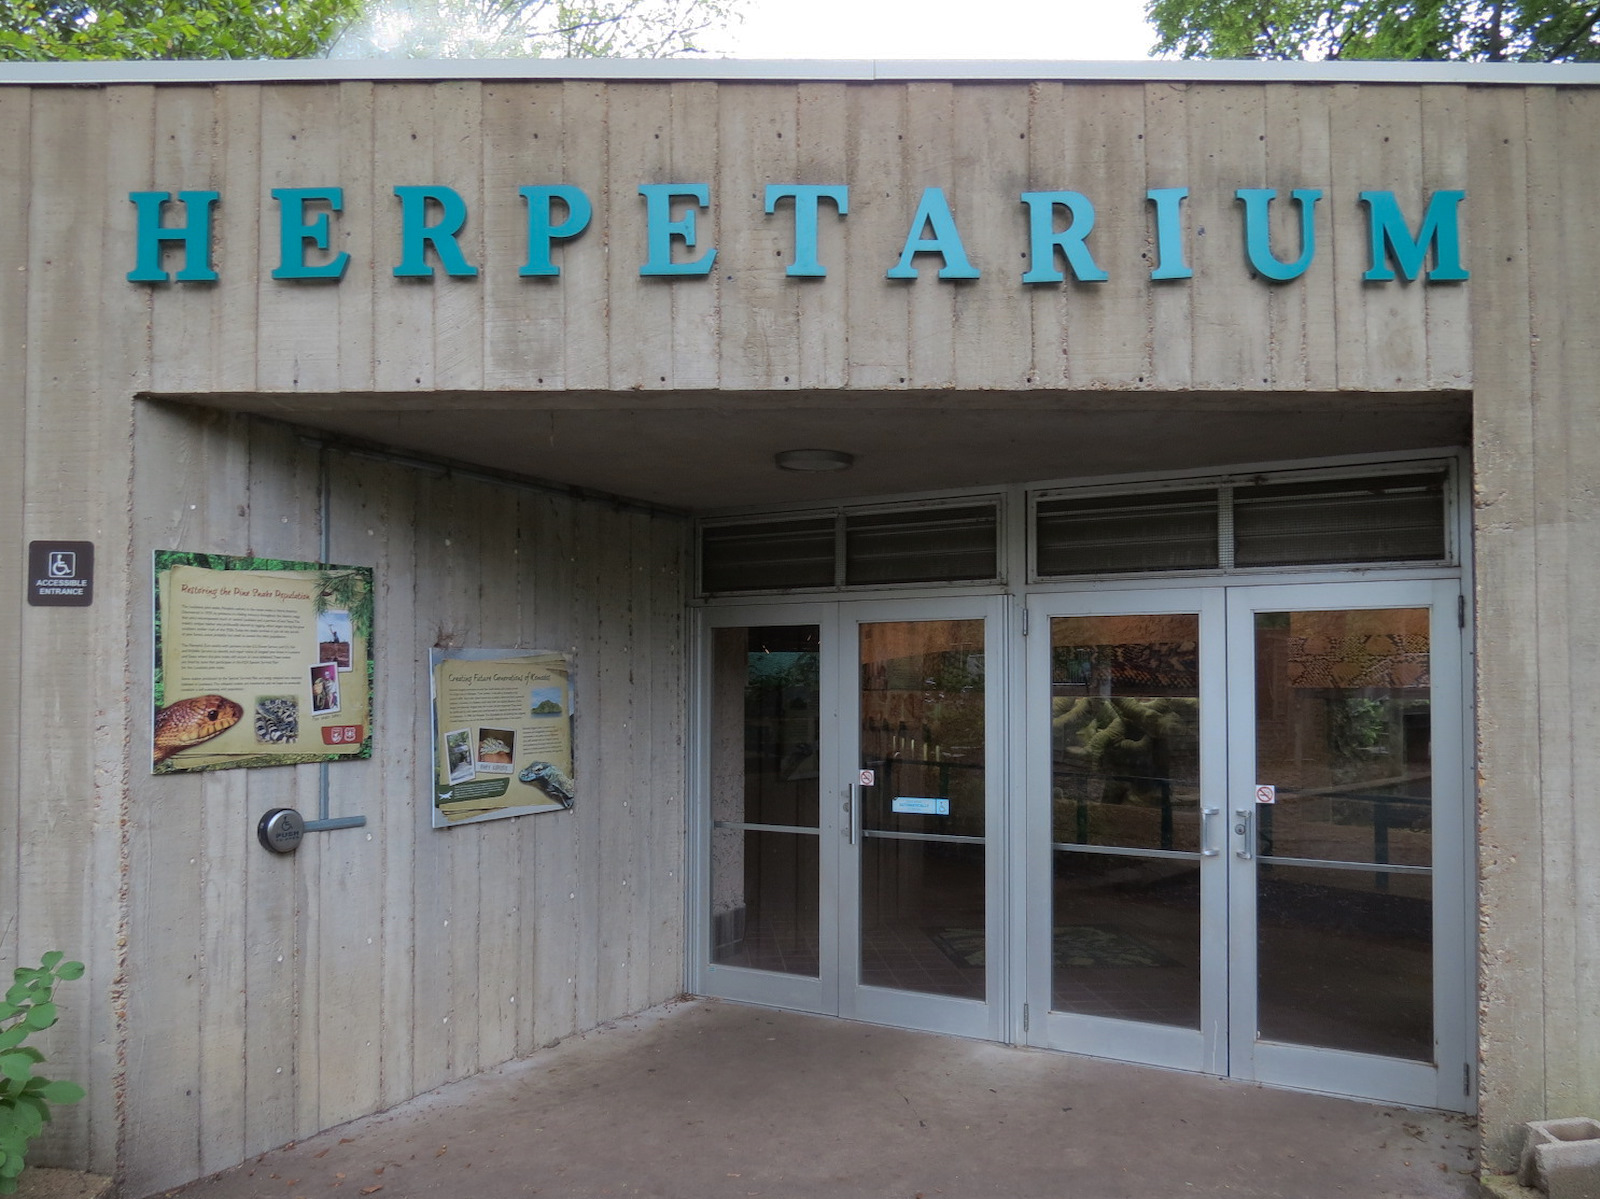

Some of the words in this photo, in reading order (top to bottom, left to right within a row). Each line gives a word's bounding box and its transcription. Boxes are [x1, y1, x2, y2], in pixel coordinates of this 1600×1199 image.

[126, 184, 1470, 284] HERPETARIUM
[181, 584, 217, 599] Restoring
[220, 586, 231, 595] the
[233, 587, 250, 597] Pine
[252, 588, 273, 598] Snake
[275, 589, 310, 602] Population
[448, 673, 472, 686] Creating
[473, 673, 492, 681] Future
[524, 671, 532, 686] of
[275, 831, 299, 839] PUSH
